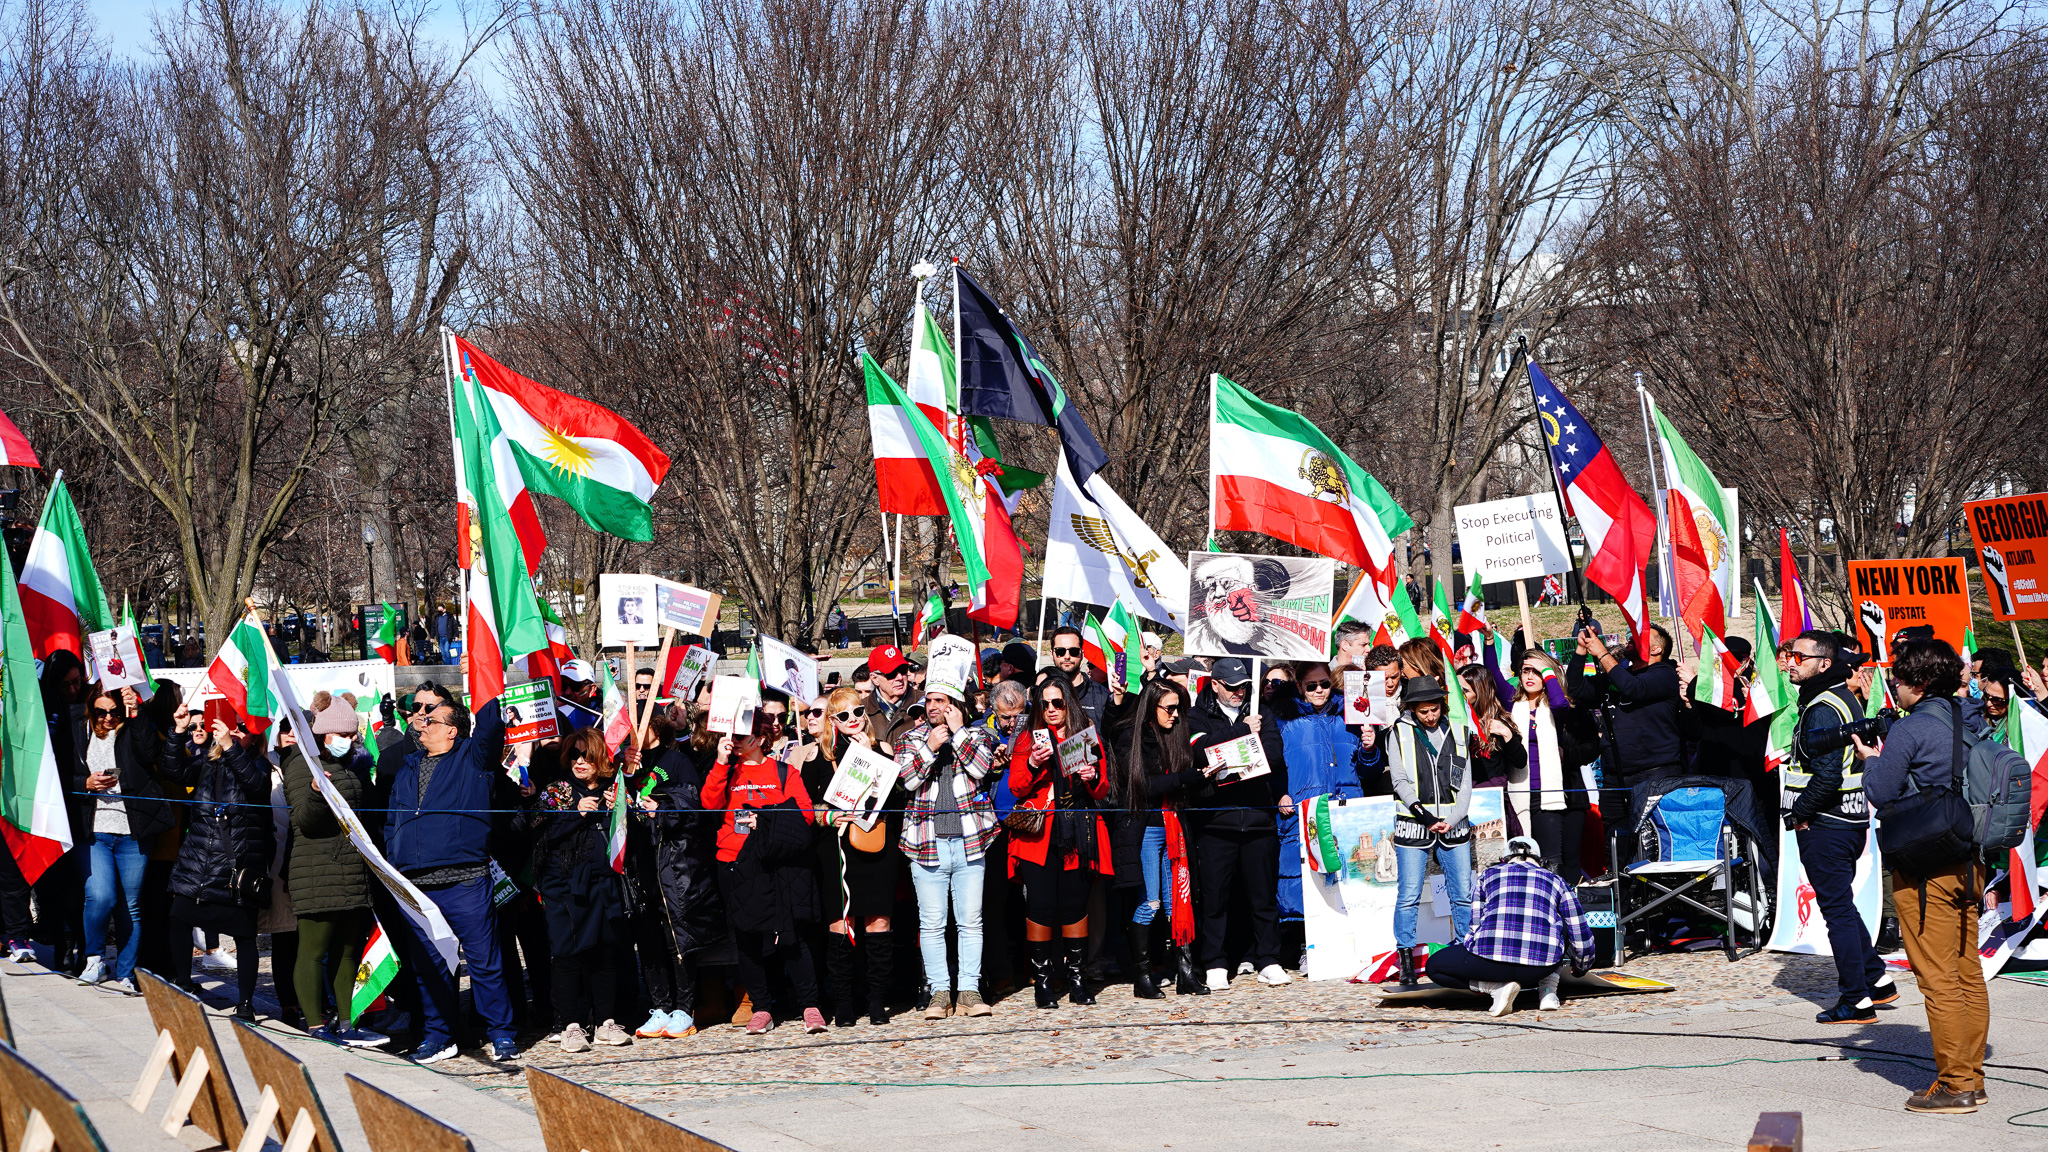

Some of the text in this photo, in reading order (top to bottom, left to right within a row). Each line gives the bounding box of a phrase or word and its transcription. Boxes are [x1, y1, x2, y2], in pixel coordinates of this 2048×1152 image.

[1461, 507, 1554, 530] Stop Executing
[1973, 500, 2048, 543] GEORGIA
[1486, 528, 1535, 546] Political
[1485, 553, 1543, 570] Prisoners
[2005, 549, 2036, 567] ATLANTA
[1855, 565, 1961, 596] NEW YORK
[1271, 594, 1329, 613] WOMEN
[1888, 606, 1927, 620] UPSTATE
[92, 633, 111, 643] STOP
[1270, 613, 1327, 656] FREEDOM
[688, 648, 702, 657] UNITY
[682, 659, 701, 672] IRAN
[514, 686, 525, 696] IN
[525, 683, 546, 694] IRAN
[1188, 683, 1197, 692] IR
[529, 700, 549, 708] WOMEN
[529, 711, 553, 719] FREEDOM
[1060, 737, 1075, 749] UNITY
[1061, 742, 1083, 757] IRAN
[1236, 740, 1250, 763] IRAN
[1249, 737, 1260, 754] UNITY
[853, 756, 871, 770] UNITY
[652, 765, 670, 782] REEDOM
[847, 766, 871, 785] IRAN
[1840, 791, 1867, 814] SECU
[1445, 820, 1469, 840] SECU
[494, 885, 513, 904] DEMO
